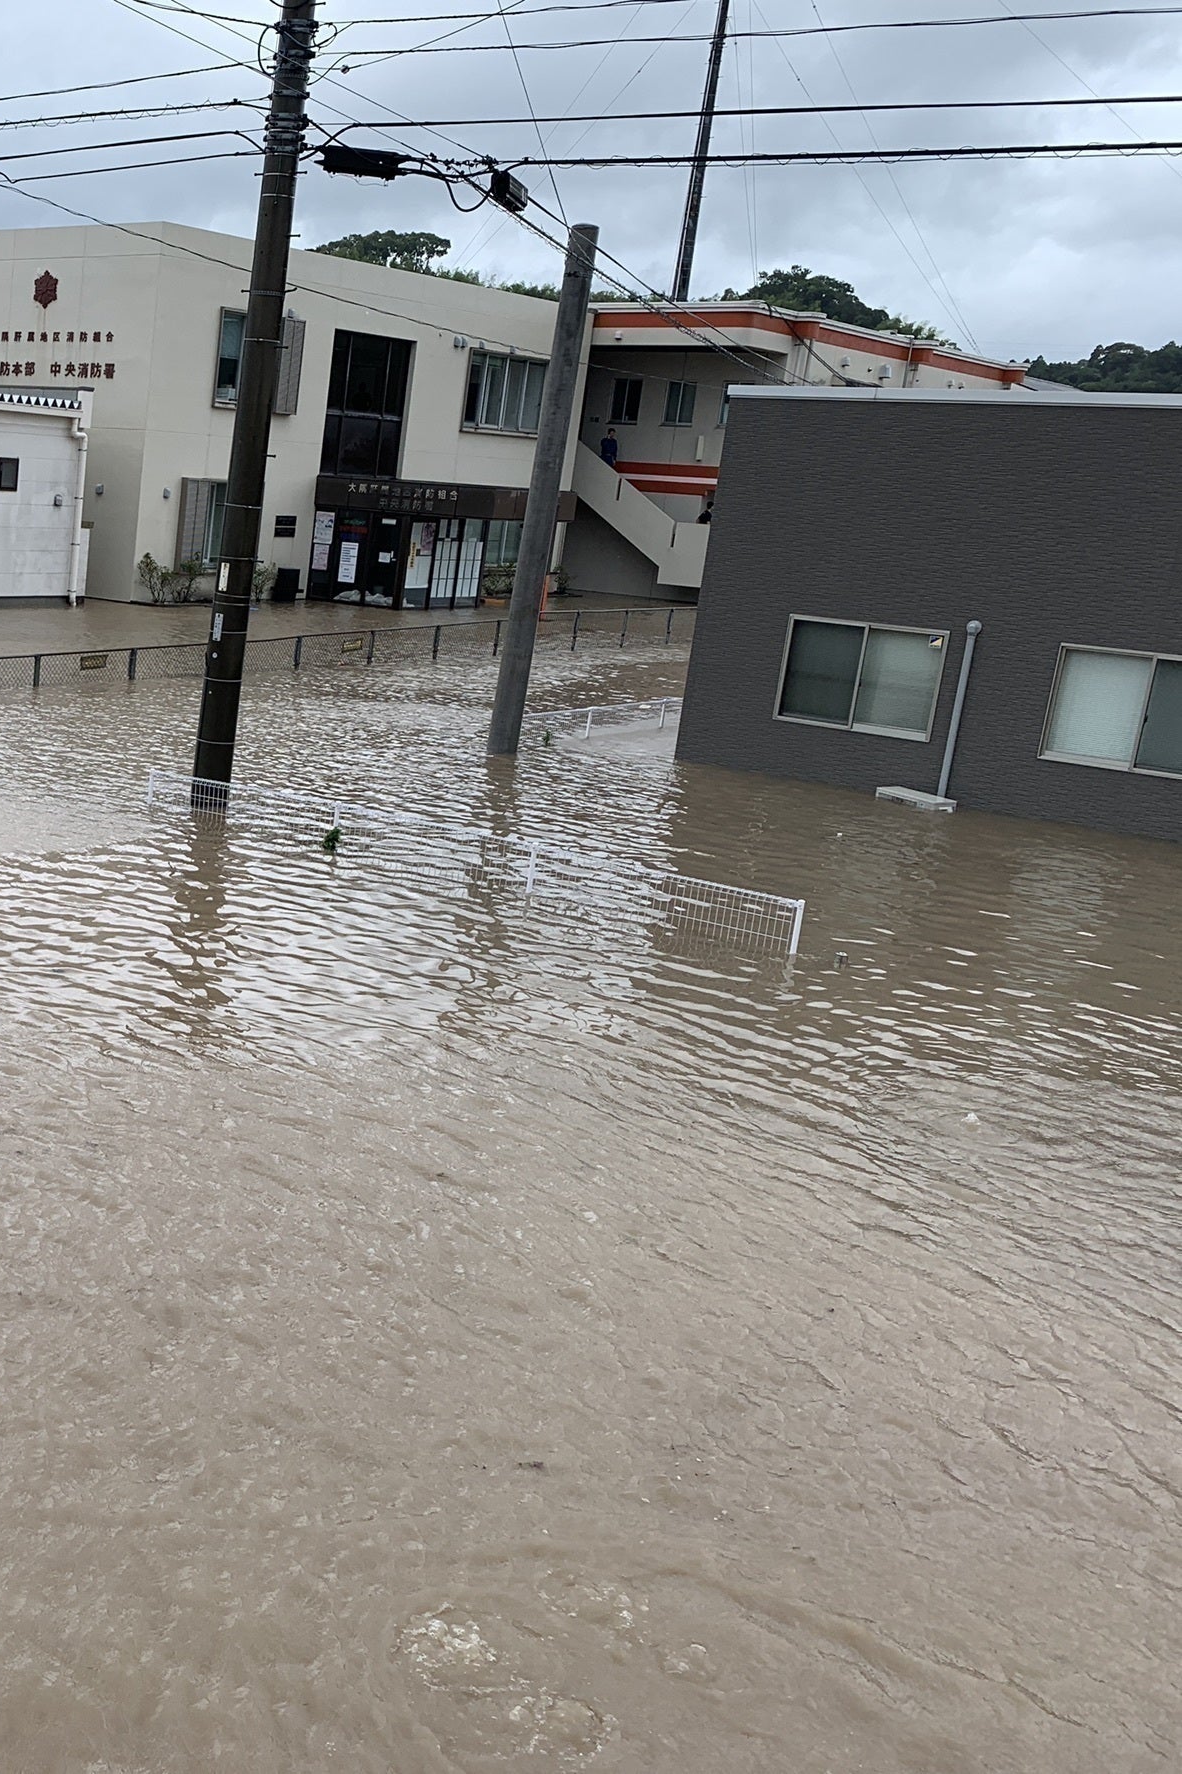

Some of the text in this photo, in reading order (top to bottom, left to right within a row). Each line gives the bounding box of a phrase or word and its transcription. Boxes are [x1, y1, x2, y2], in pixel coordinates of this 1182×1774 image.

[50, 361, 116, 379] 中央消防署
